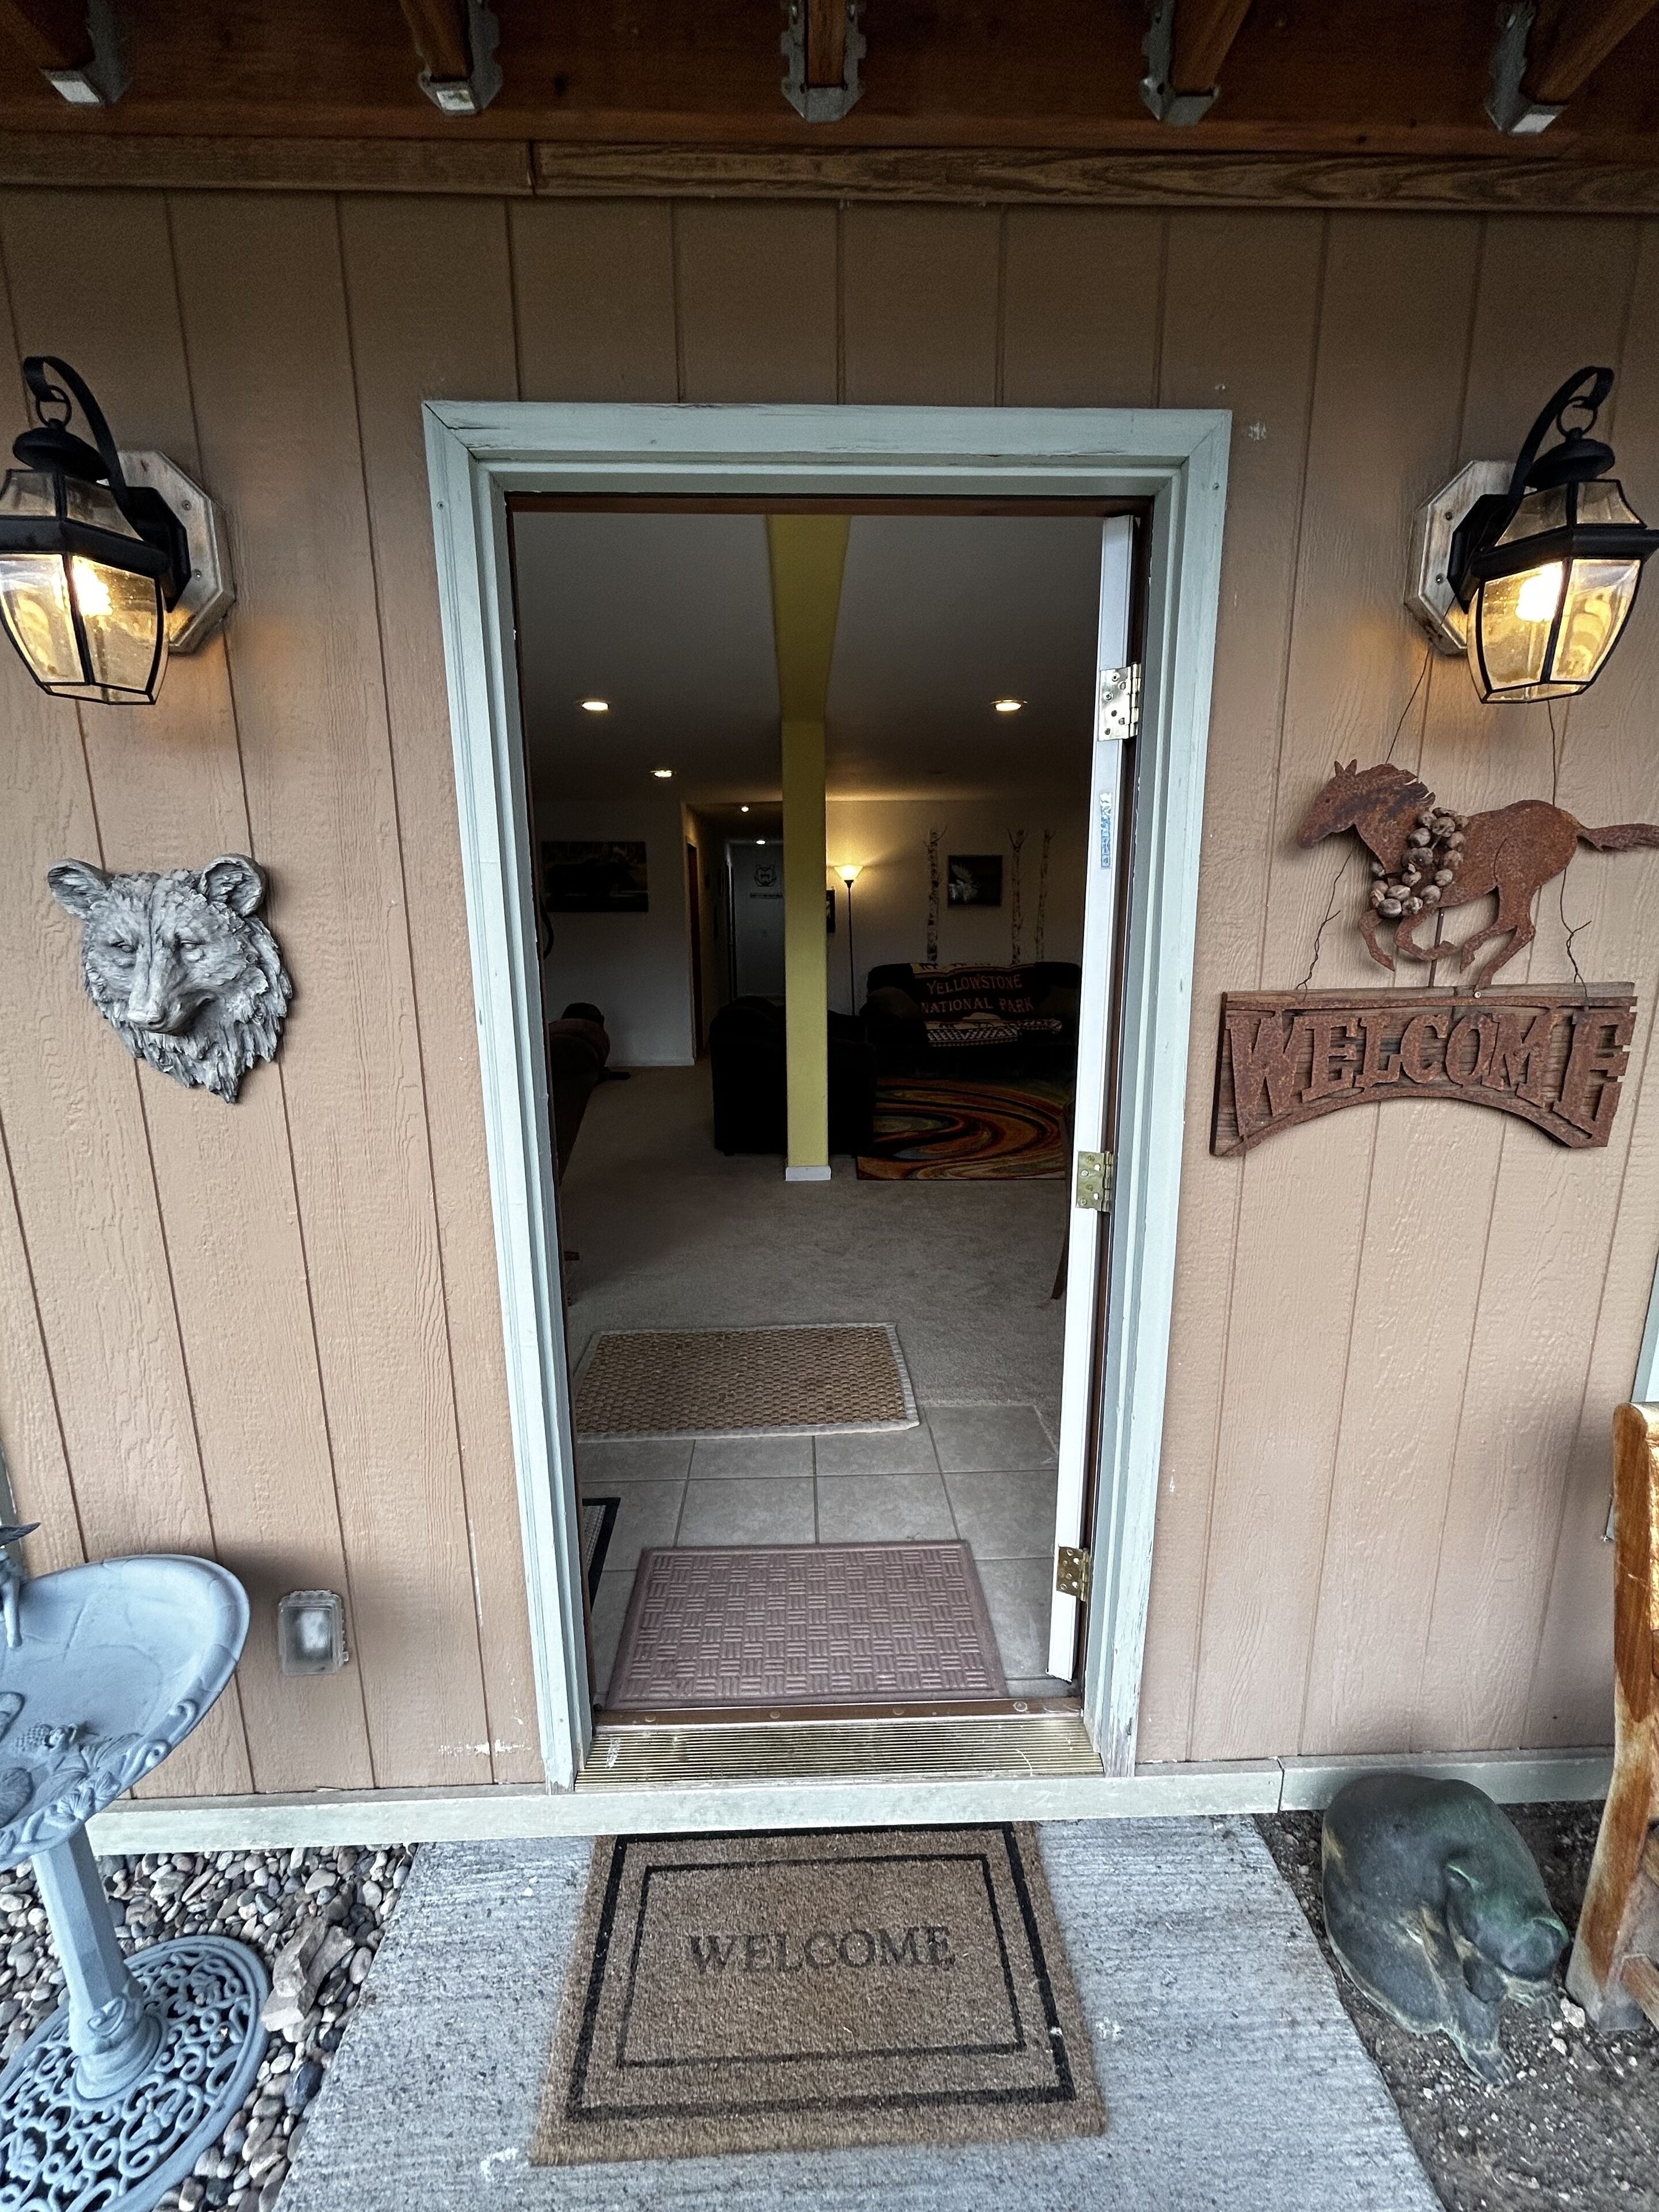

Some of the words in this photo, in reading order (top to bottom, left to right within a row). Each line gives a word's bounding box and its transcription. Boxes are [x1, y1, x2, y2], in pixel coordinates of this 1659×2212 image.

[926, 974, 1022, 995] YELLOWSTONE
[922, 998, 993, 1013] NATIONAL
[998, 997, 1034, 1013] PARK
[1225, 1011, 1637, 1146] WELCOME
[689, 1926, 956, 1974] WELCOME
